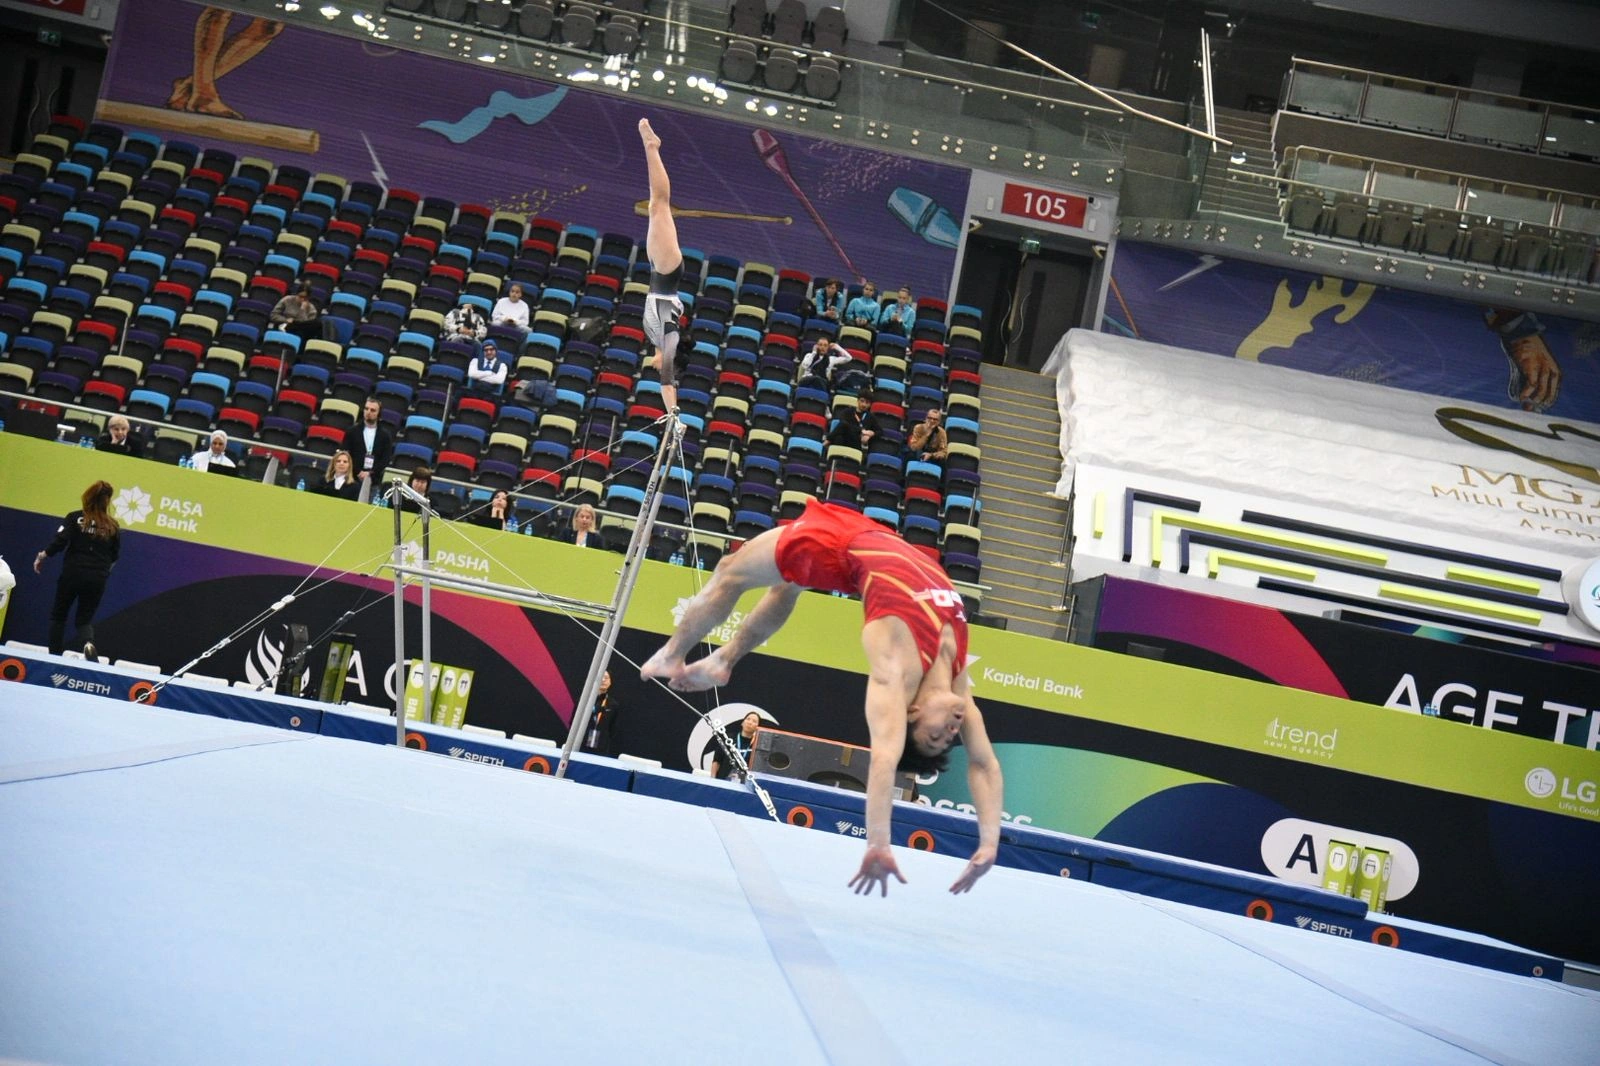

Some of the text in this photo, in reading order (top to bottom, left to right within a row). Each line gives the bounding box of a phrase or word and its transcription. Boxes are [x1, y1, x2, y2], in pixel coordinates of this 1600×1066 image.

[1023, 192, 1068, 220] 105
[1458, 464, 1600, 509] MG
[160, 496, 204, 518] PAŞA
[156, 513, 199, 533] Bank
[436, 549, 490, 573] PASHA
[66, 678, 112, 696] SPIETH
[983, 667, 1085, 699] Kapital Bank
[1272, 717, 1338, 751] trend
[464, 751, 505, 767] SPIETH
[1560, 776, 1597, 803] LG
[1285, 832, 1319, 875] A
[1310, 920, 1354, 938] SPIETH
